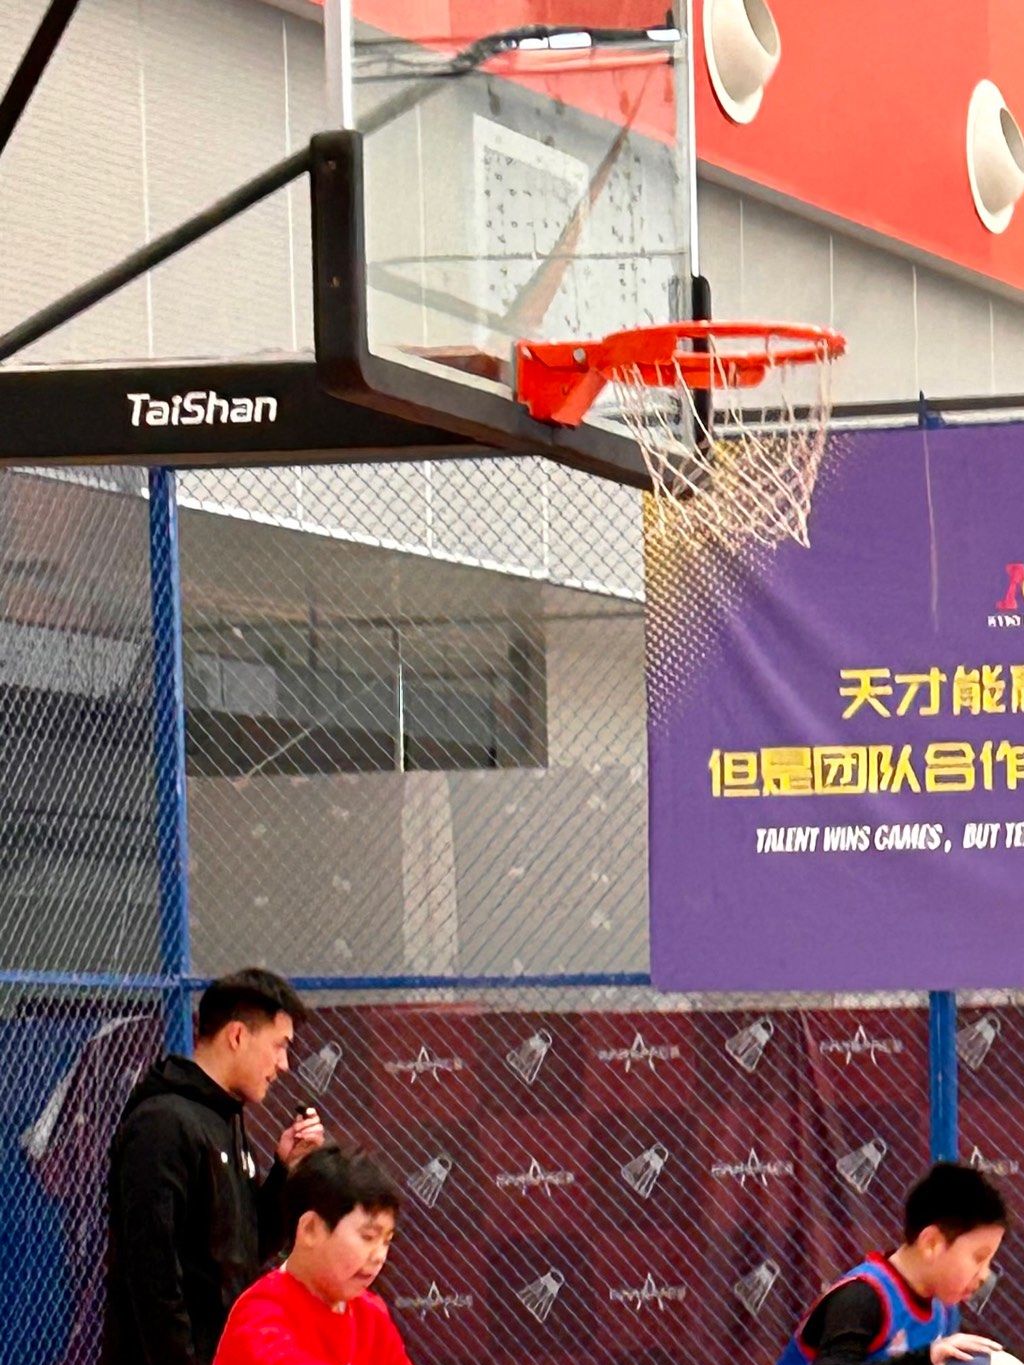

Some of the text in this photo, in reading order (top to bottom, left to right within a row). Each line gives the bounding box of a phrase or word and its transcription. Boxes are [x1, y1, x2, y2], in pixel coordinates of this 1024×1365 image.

[127, 390, 278, 426] TaiShan
[756, 826, 819, 853] TALENT
[823, 825, 870, 852] WINS
[963, 822, 999, 849] BUT
